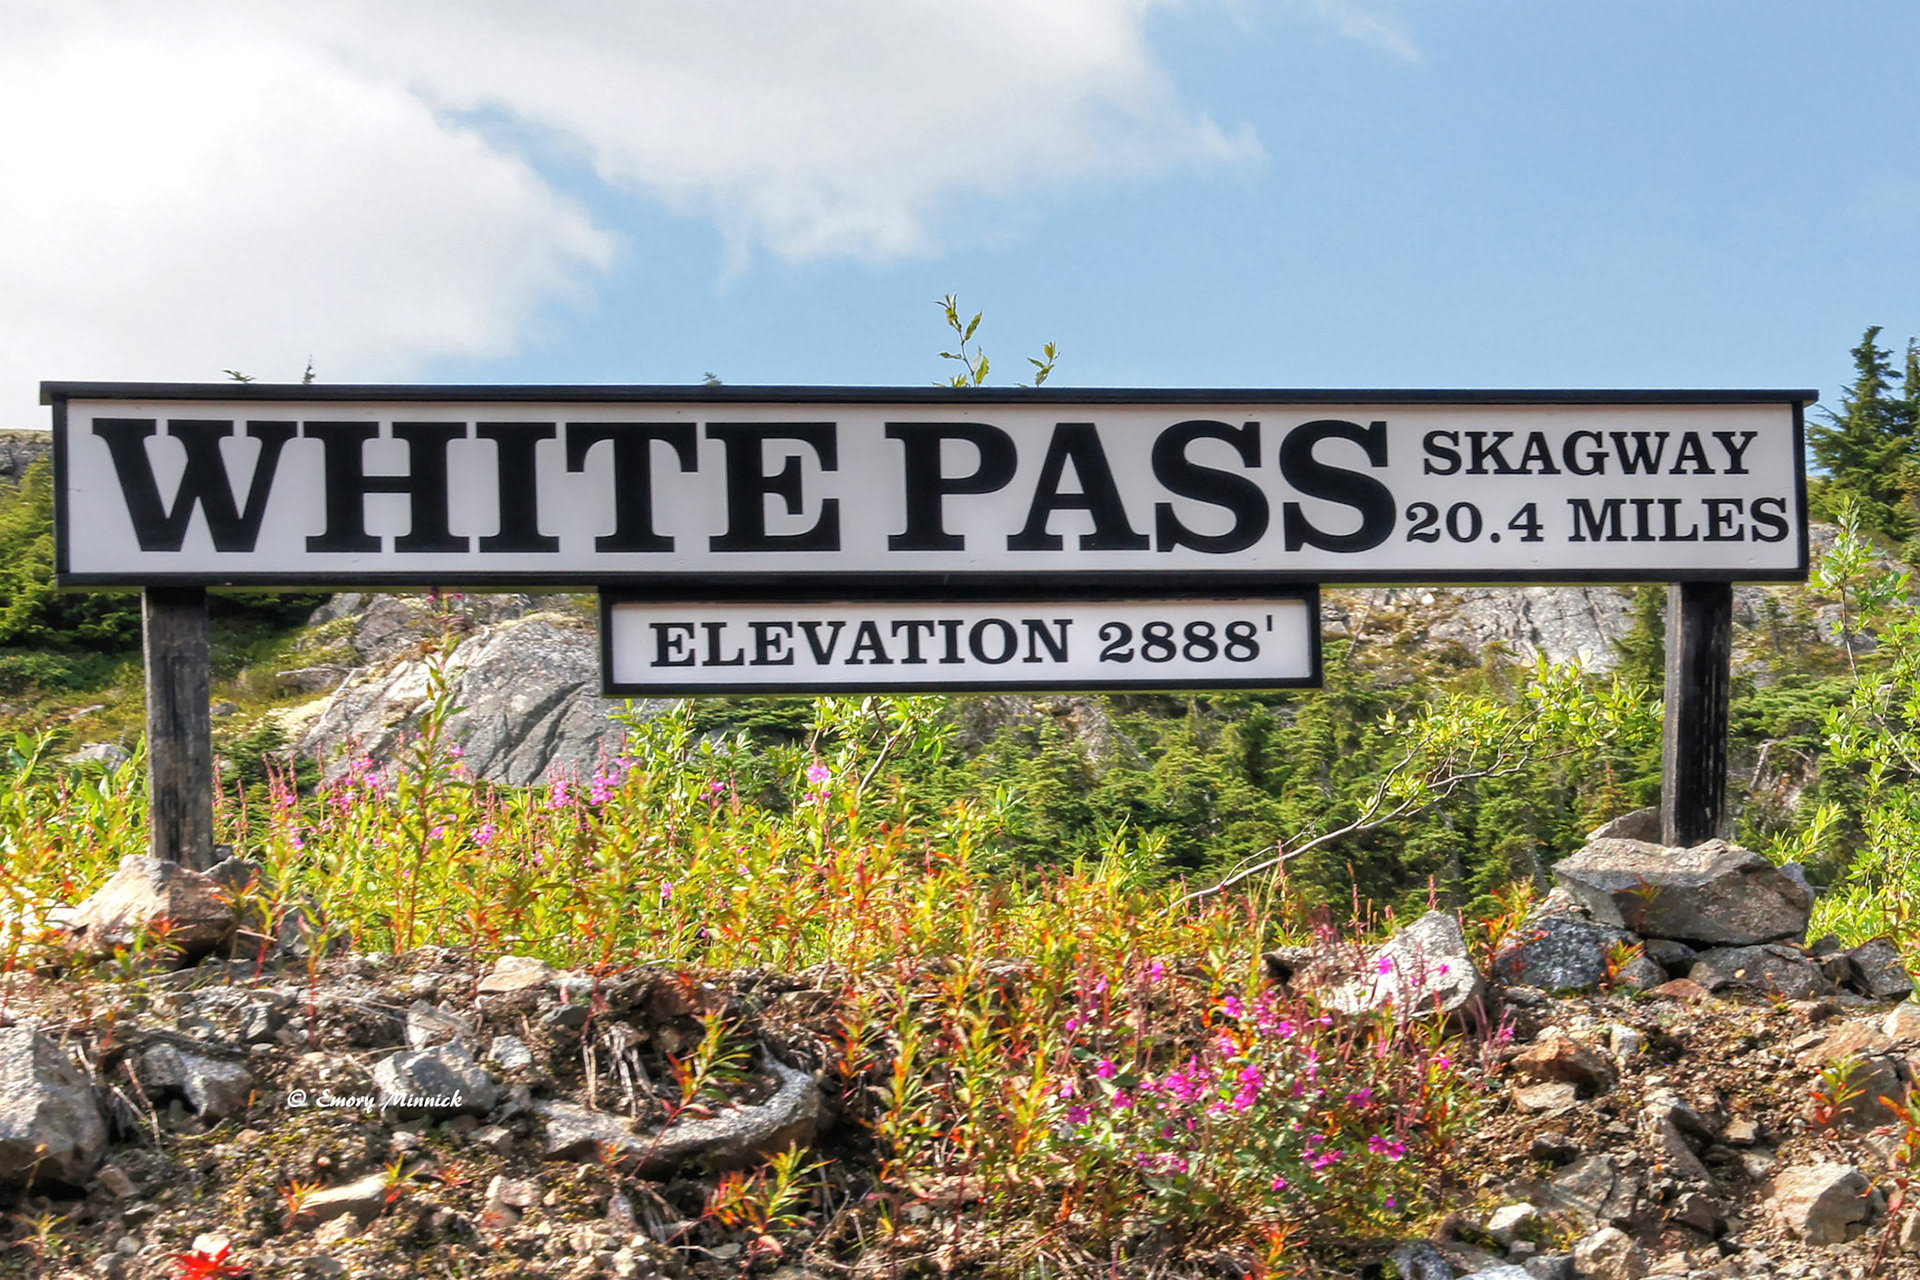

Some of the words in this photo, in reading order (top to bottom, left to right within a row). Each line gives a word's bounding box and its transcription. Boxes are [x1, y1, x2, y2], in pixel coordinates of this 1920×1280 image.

[1422, 430, 1758, 476] SKAGWAY
[91, 417, 841, 554] WHITE
[884, 419, 1397, 555] PASS
[1405, 501, 1545, 544] 20.4
[1566, 497, 1789, 543] MILES
[649, 618, 1073, 668] ELEVATION
[1098, 614, 1274, 664] 2888'
